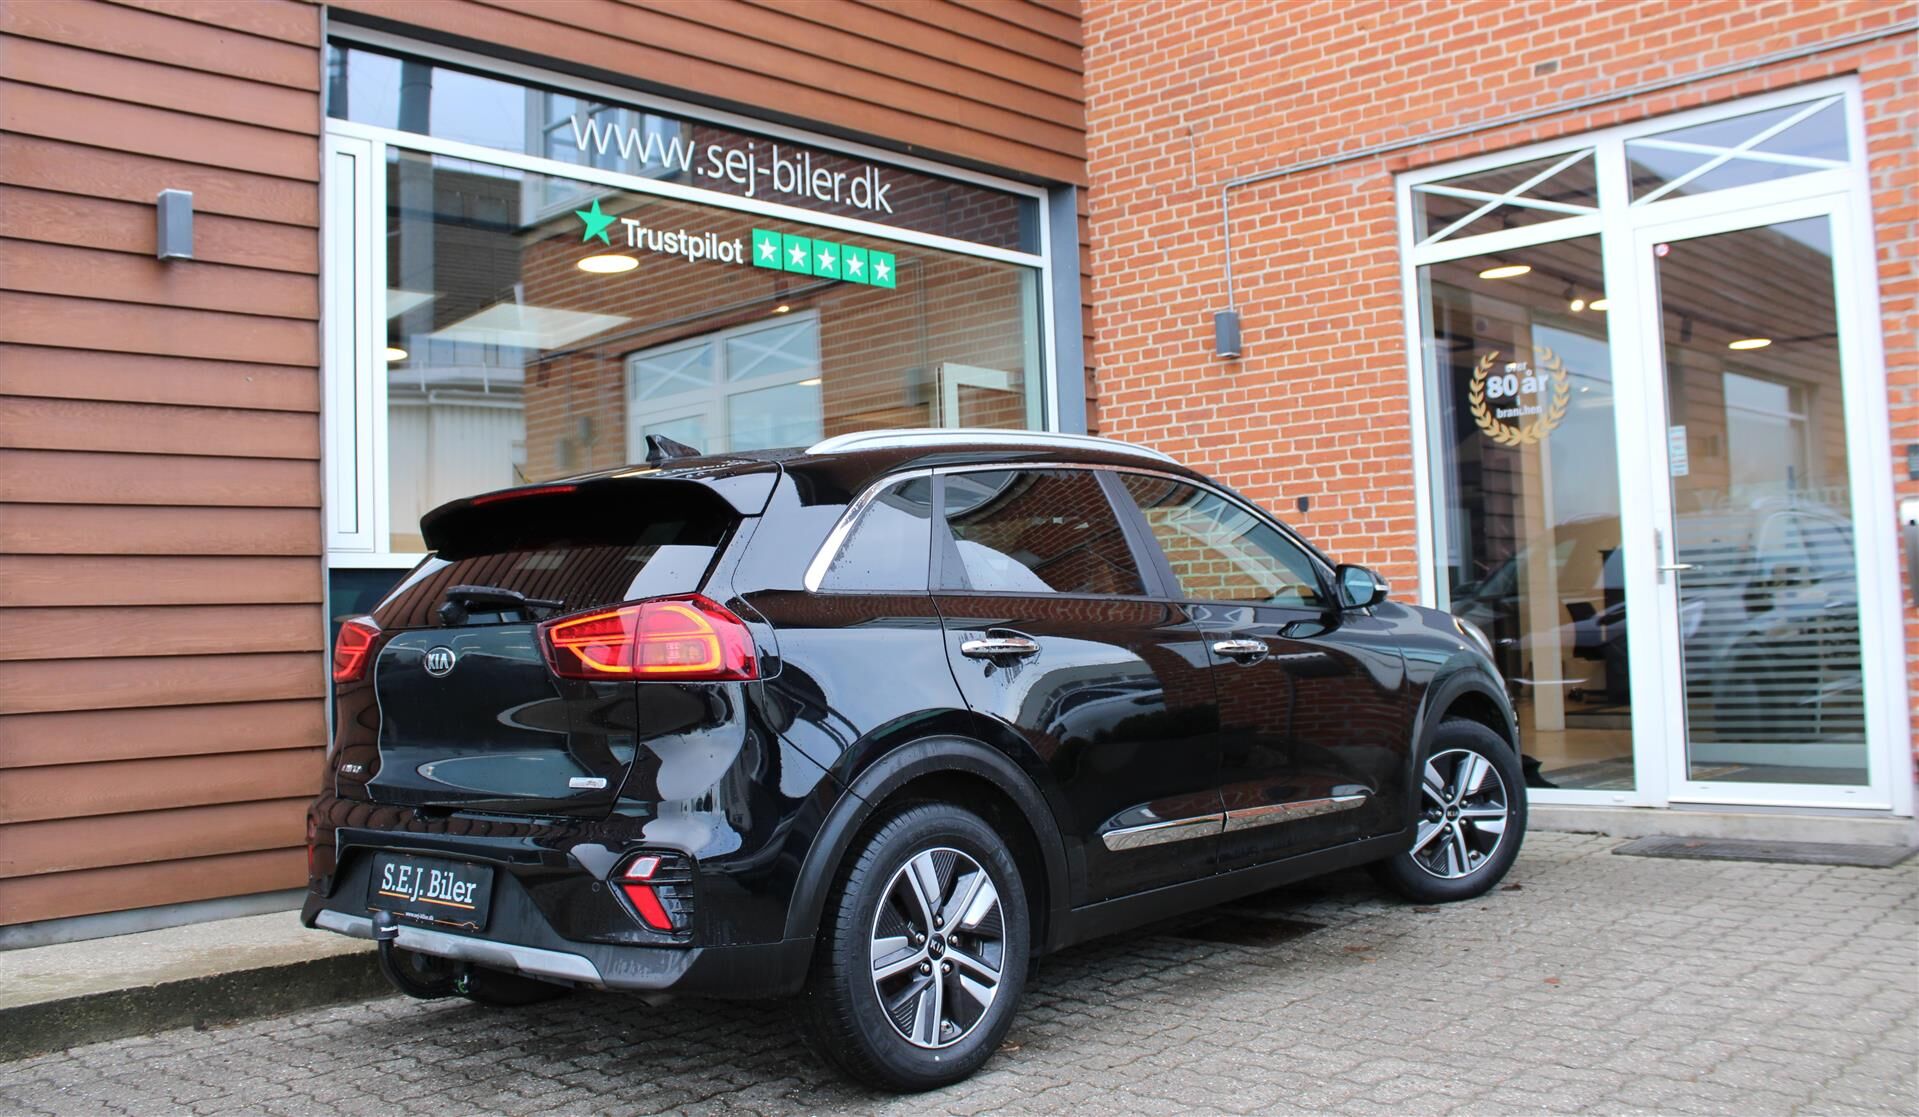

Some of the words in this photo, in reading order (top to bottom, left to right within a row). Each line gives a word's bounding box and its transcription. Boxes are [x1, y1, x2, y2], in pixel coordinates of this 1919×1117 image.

[571, 115, 893, 214] www.sej-biler.dk
[620, 217, 744, 264] Trustpilot
[1487, 373, 1518, 398] 80
[1521, 369, 1549, 393] år
[427, 653, 450, 670] KIA
[381, 862, 424, 902] S.E.J.
[427, 868, 477, 904] Biler
[929, 941, 945, 955] KIA
